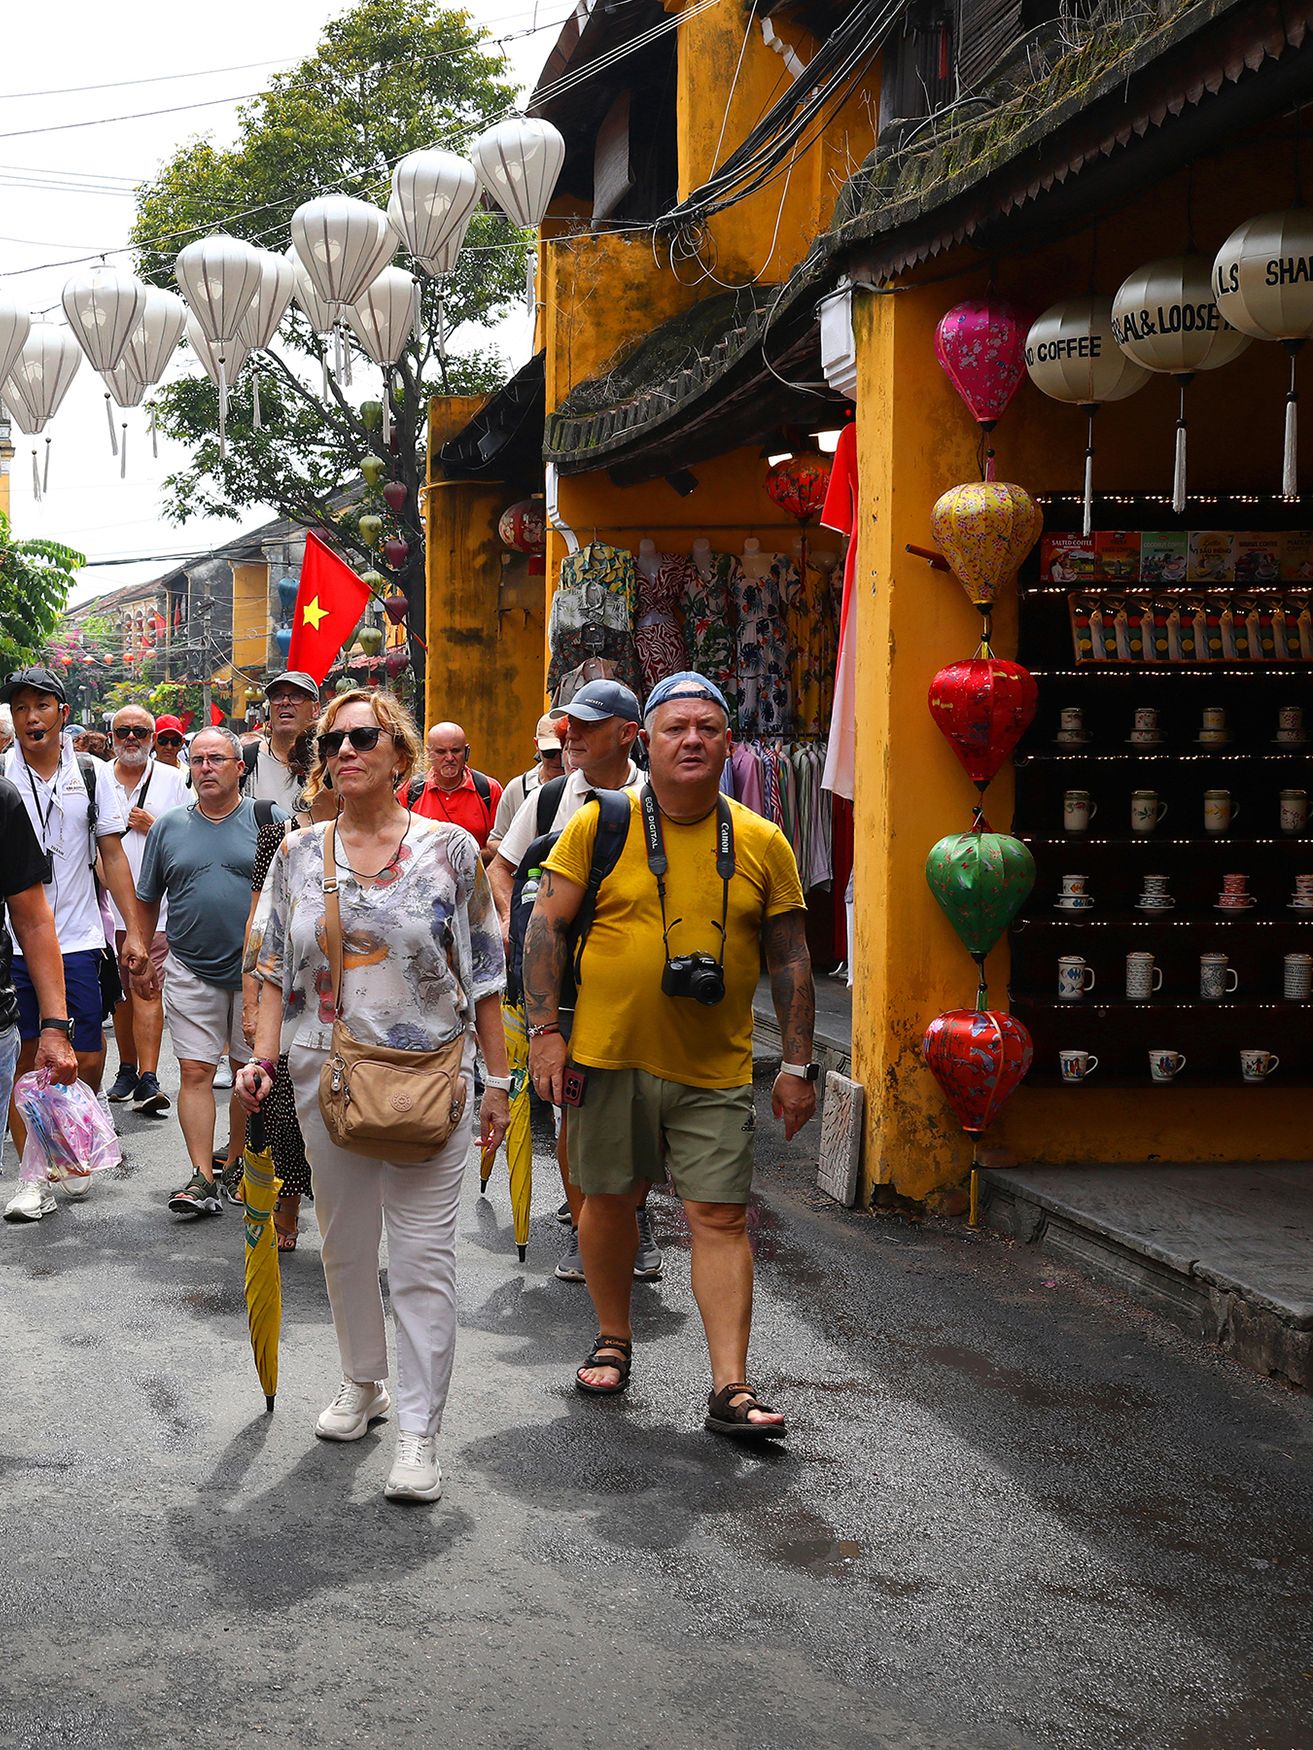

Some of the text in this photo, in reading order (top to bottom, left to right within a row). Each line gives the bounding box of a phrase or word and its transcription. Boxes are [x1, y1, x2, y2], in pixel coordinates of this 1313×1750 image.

[1217, 263, 1239, 298] LS
[1157, 303, 1221, 334] LOOSE
[1037, 336, 1102, 362] COFFEE
[645, 796, 659, 849] EOS DIGITAL
[721, 822, 730, 853] Canon
